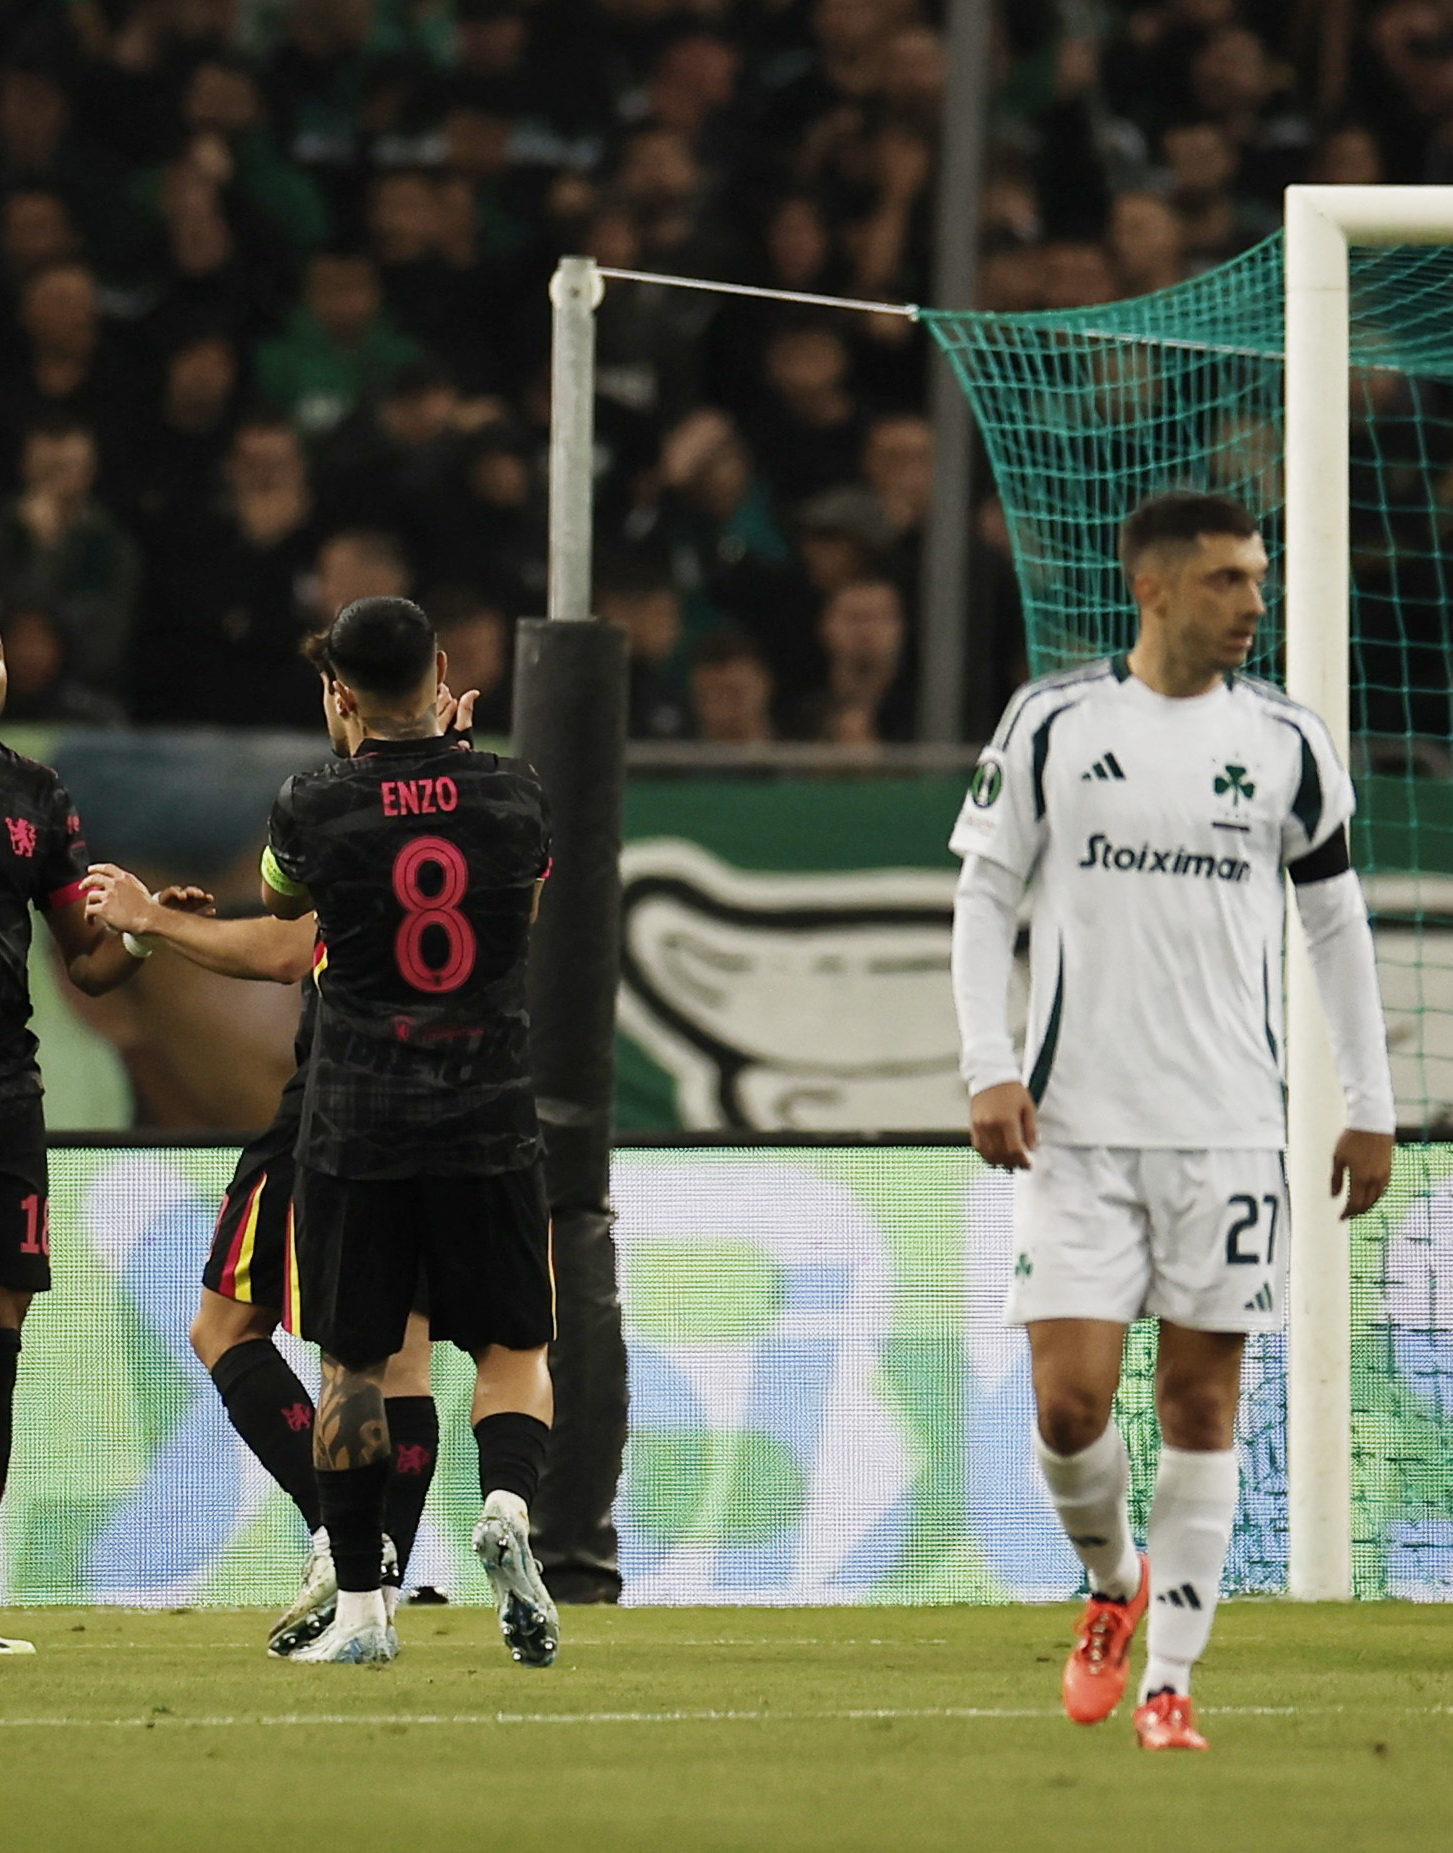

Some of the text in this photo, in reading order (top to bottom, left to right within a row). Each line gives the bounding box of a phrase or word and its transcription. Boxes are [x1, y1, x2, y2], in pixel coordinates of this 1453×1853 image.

[381, 776, 458, 816] ENZO
[392, 835, 476, 993] 8
[1226, 1194, 1278, 1265] 27
